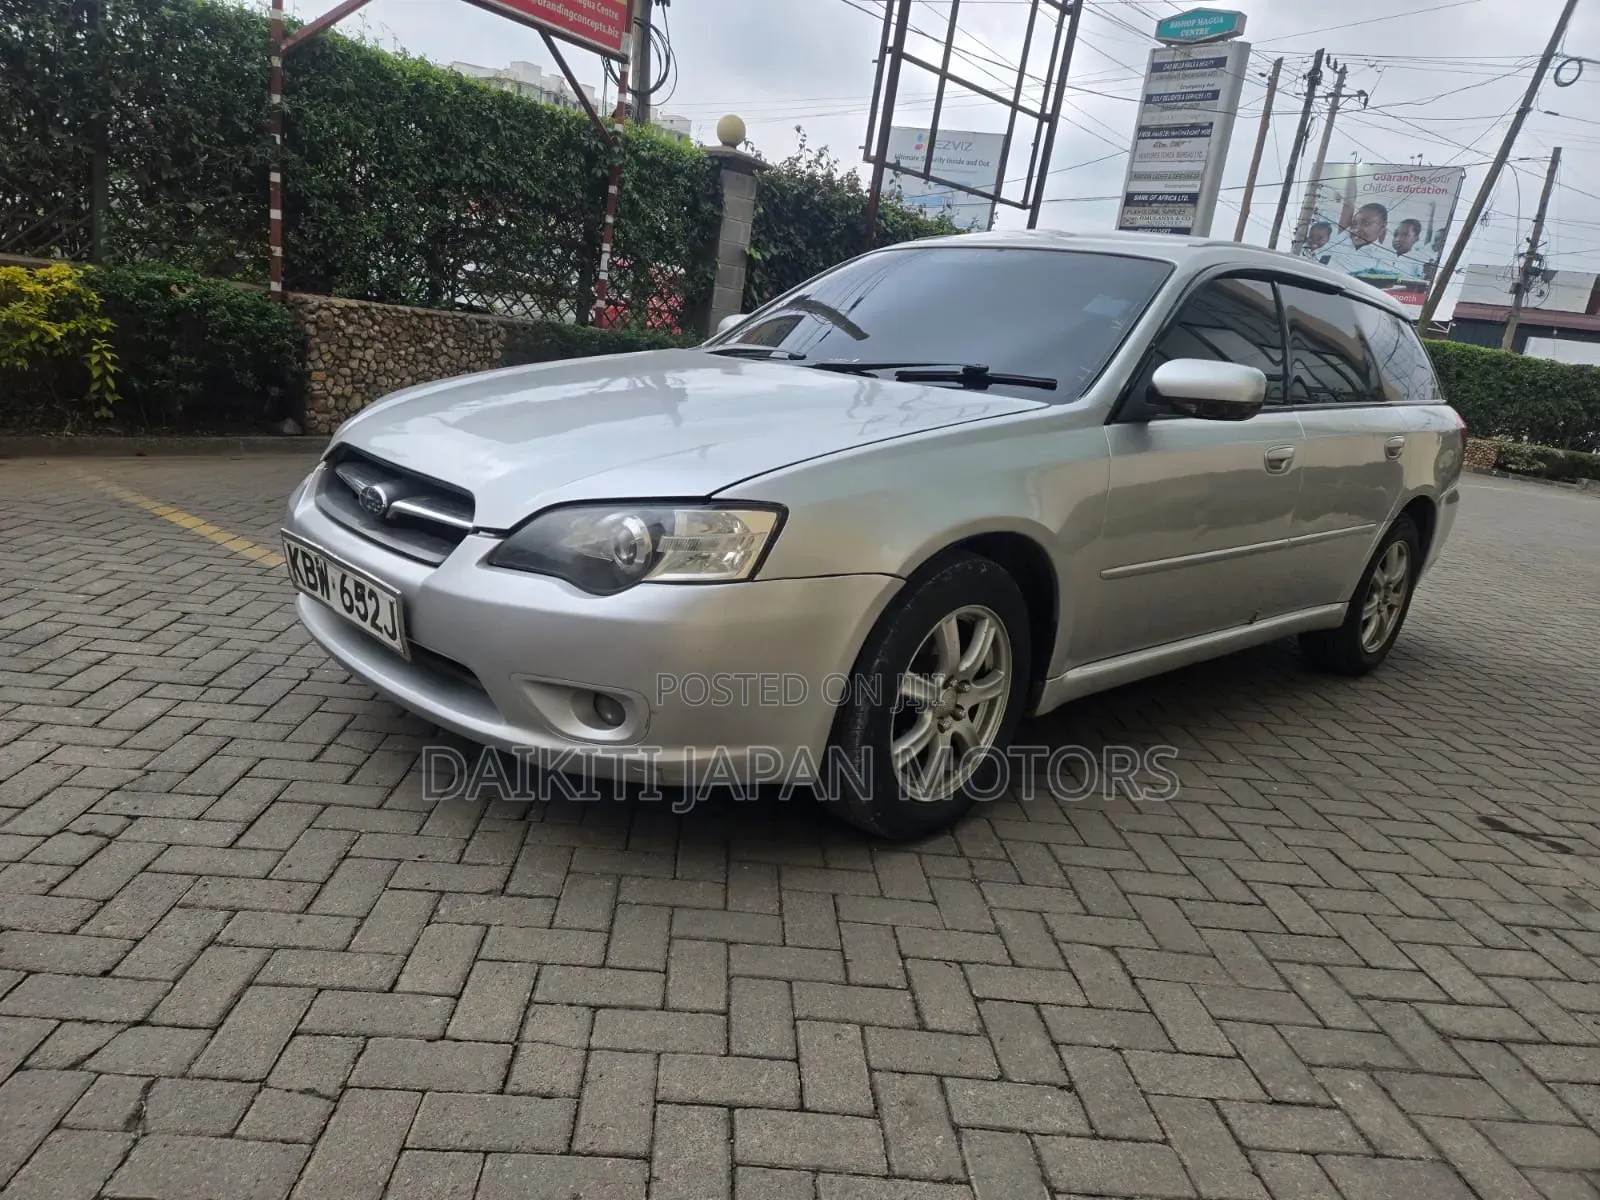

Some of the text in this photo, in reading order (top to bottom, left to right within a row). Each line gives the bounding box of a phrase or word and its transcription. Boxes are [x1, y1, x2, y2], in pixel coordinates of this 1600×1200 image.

[576, 0, 619, 20] agua Centre
[531, 0, 620, 38] brandingconcepts.biz
[1169, 19, 1196, 29] BISHOP
[1180, 27, 1210, 37] CENTRE
[921, 155, 946, 167] Surity
[1373, 172, 1451, 185] Guarantee your
[1363, 183, 1448, 195] Child's Education
[287, 543, 398, 642] KBW 652J
